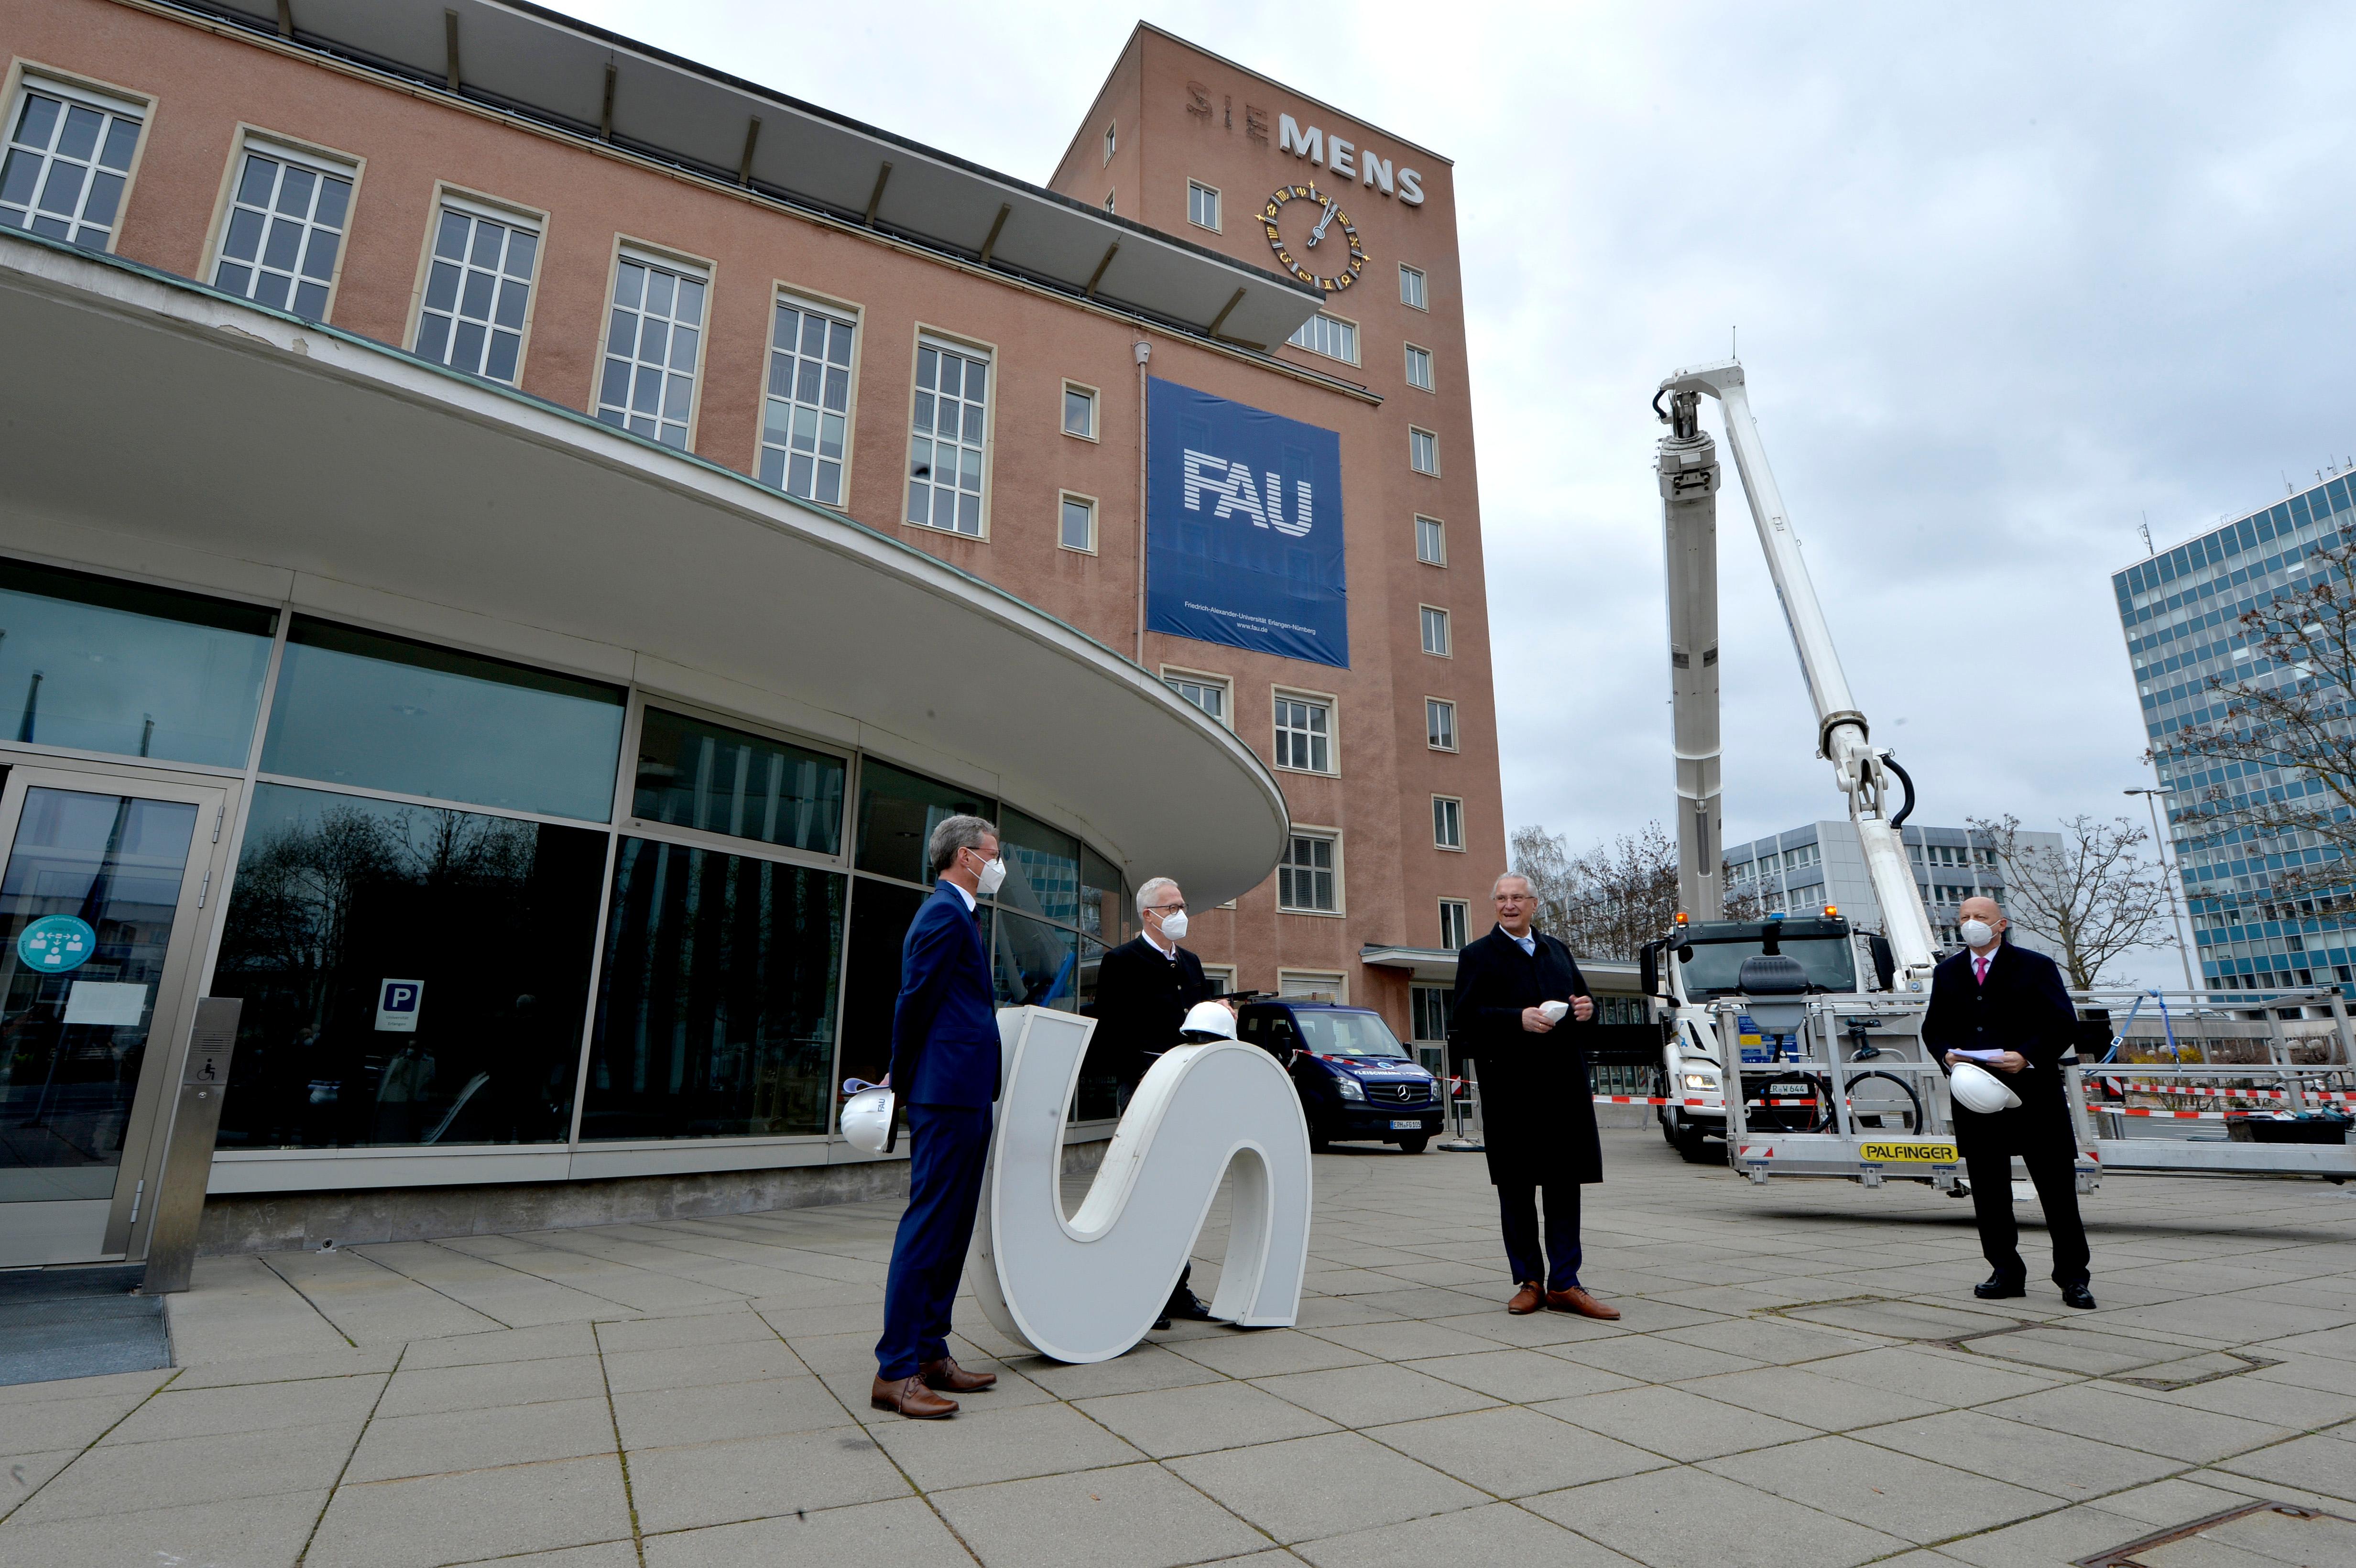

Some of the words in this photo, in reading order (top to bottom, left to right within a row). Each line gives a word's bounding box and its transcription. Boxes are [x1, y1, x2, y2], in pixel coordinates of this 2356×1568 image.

[1184, 448, 1312, 537] FAU
[1185, 600, 1266, 624] Friedrich-Alexander-Universität
[1268, 619, 1316, 635] Erlangen-Nürnberg
[1236, 621, 1268, 633] www.fau.de
[392, 988, 411, 1007] P
[877, 1099, 885, 1112] FAU
[1866, 1145, 1953, 1159] PALFINGER
